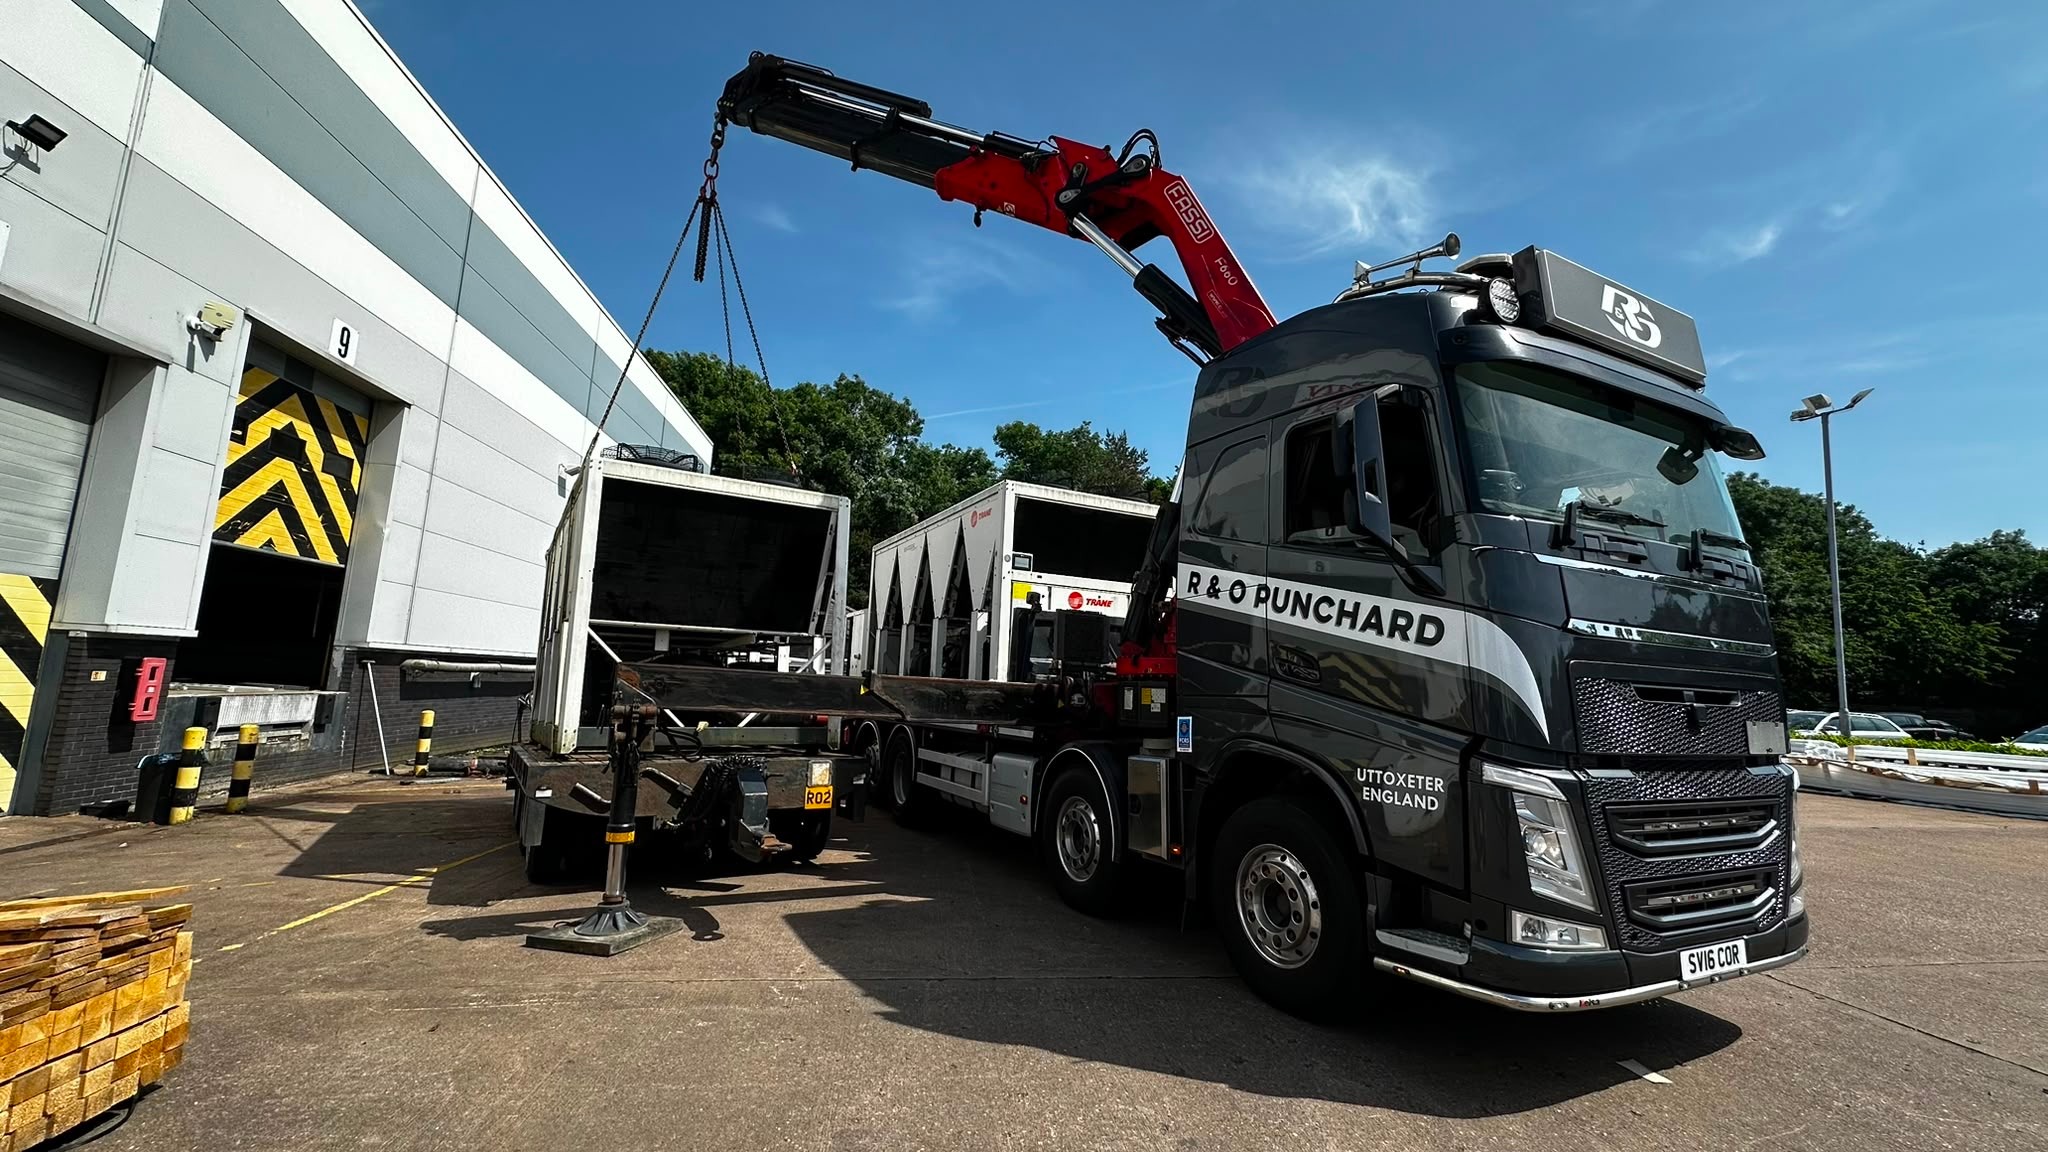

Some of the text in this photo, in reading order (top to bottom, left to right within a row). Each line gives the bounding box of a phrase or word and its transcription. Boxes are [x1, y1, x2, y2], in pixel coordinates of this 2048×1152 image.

[1168, 184, 1210, 239] FASSI
[337, 326, 351, 359] 9
[1086, 598, 1114, 608] TRANE
[1187, 571, 1446, 647] R & O PUNCHARD
[1357, 767, 1445, 793] UTTOXETER
[1362, 786, 1439, 811] ENGLAND
[1688, 943, 1740, 974] SV16 COR
